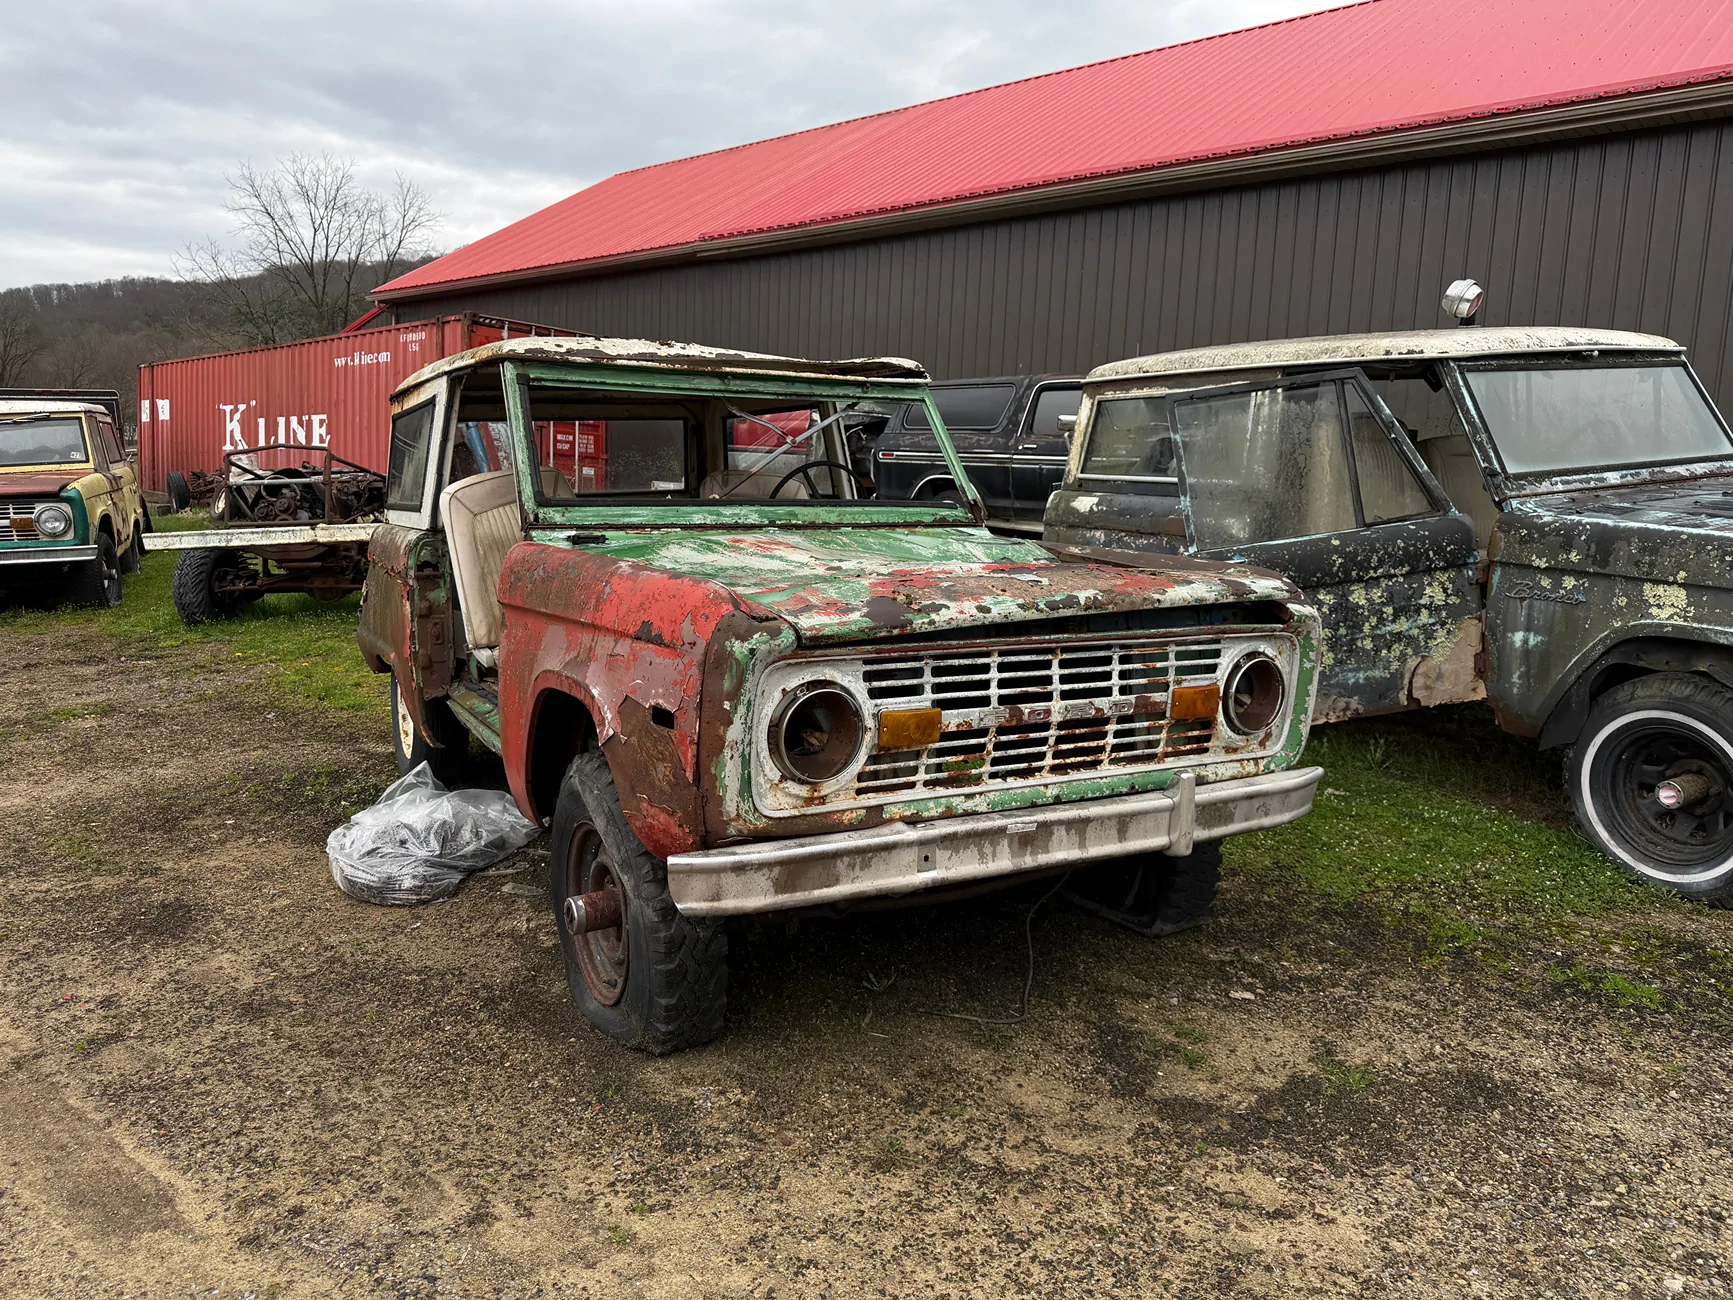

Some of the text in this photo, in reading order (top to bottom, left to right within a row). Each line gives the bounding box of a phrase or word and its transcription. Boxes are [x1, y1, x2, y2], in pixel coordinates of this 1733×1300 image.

[258, 414, 331, 449] LINE
[1505, 580, 1586, 605] Bronco
[978, 699, 1134, 728] FORD
